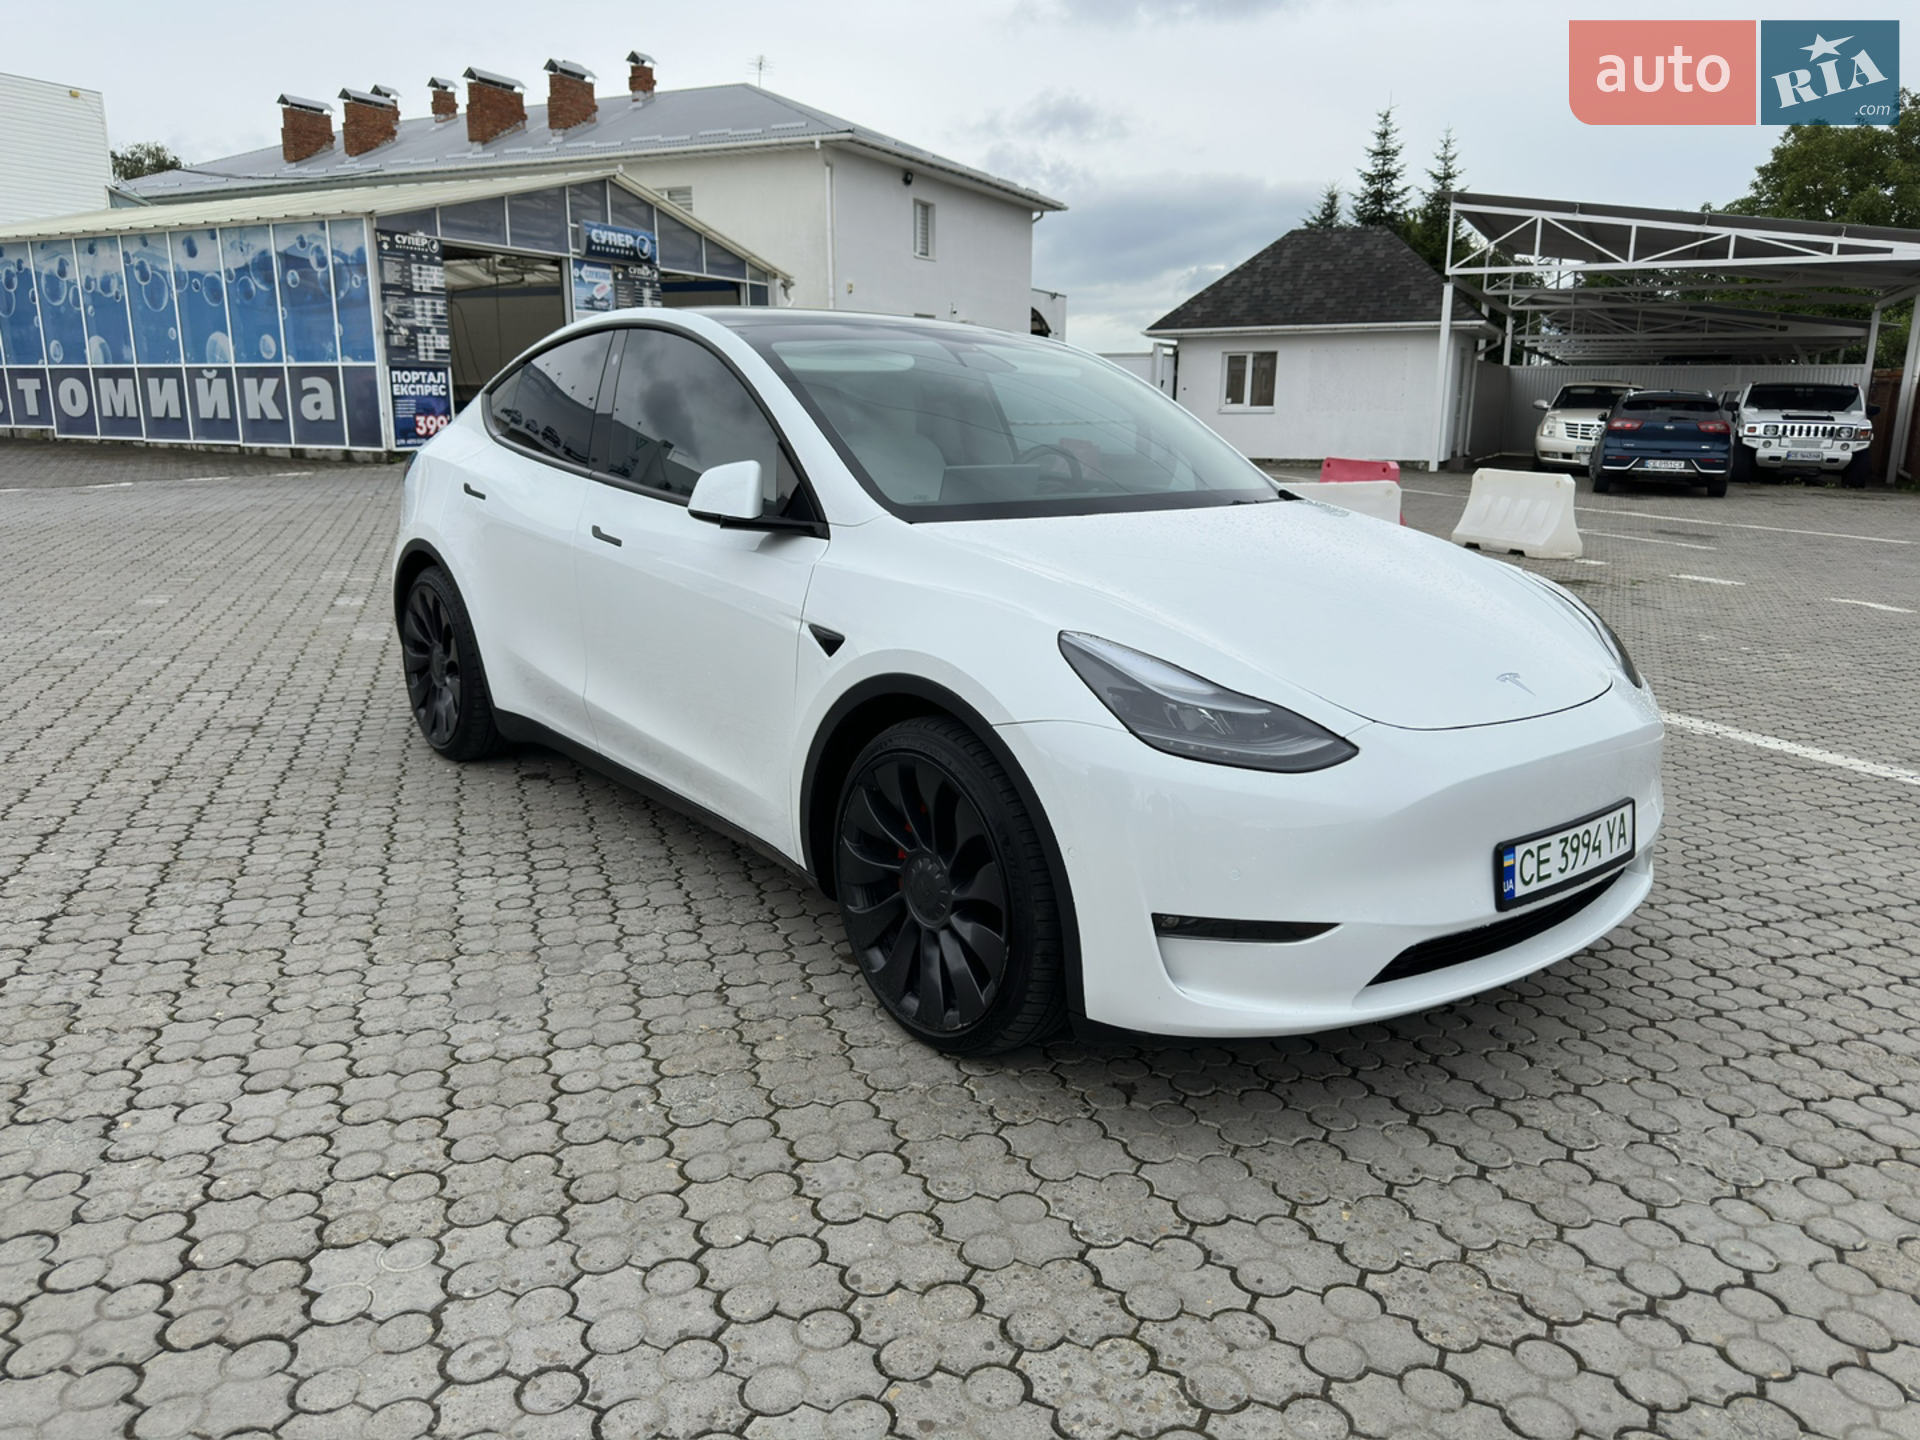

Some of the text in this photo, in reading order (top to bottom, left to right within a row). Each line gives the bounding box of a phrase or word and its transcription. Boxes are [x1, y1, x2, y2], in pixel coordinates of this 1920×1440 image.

[394, 234, 428, 247] СУПЕР
[591, 228, 634, 248] СУПЕР
[391, 370, 446, 384] ПОРТАЛ
[0, 369, 336, 421] томийка
[392, 383, 447, 396] ЕКСПРЕС
[1519, 812, 1628, 886] CE 3994 YA
[1503, 879, 1514, 892] UA
